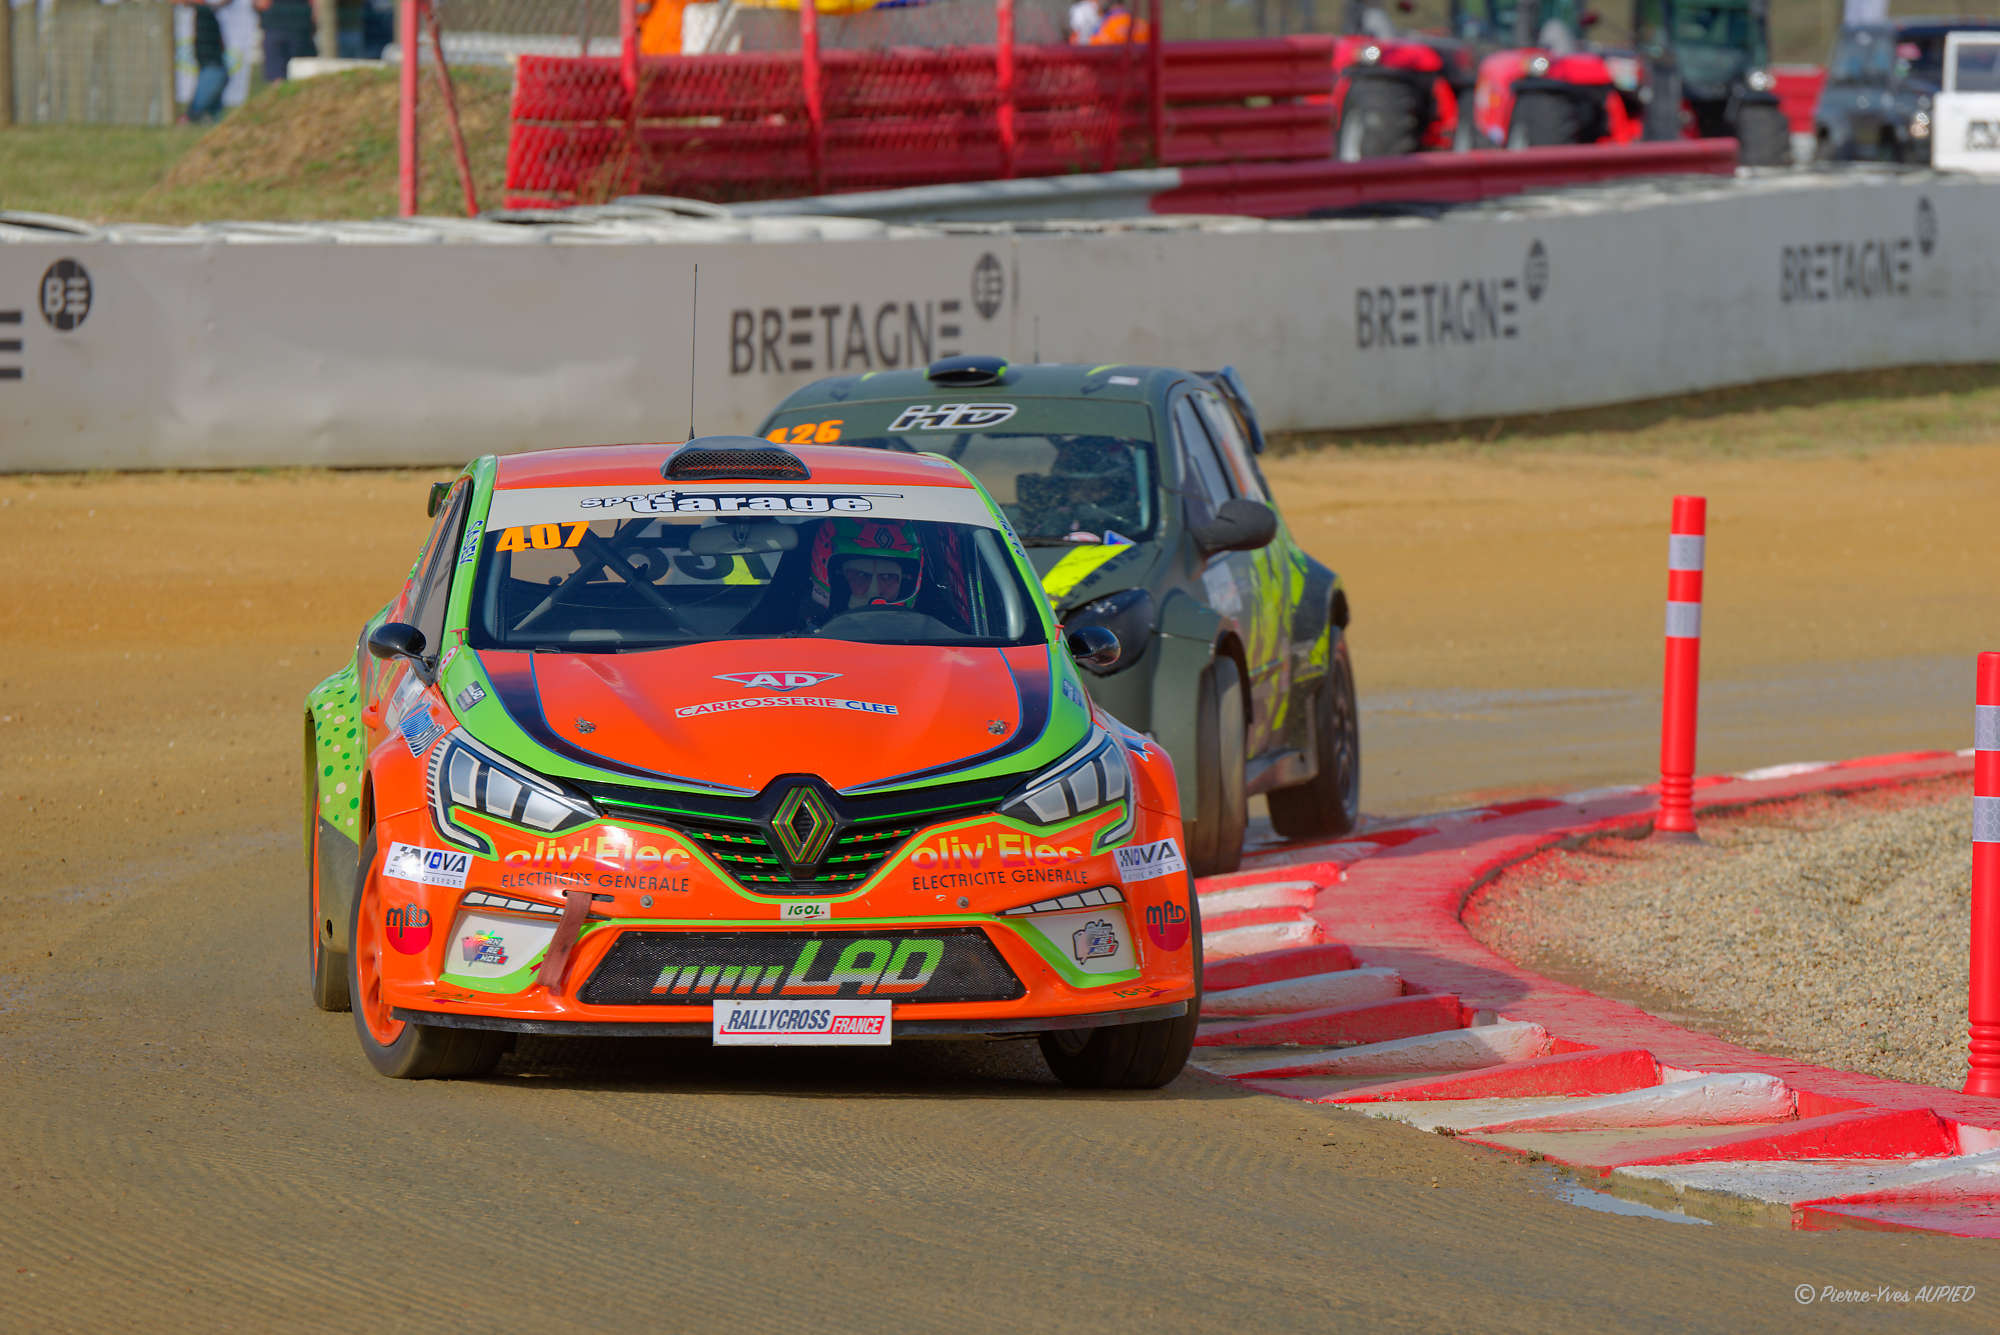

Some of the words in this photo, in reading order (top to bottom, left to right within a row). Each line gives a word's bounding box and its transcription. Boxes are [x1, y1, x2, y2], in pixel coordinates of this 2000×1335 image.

[1779, 238, 1911, 302] BRETAGNE
[1355, 278, 1520, 349] BRETAGNE
[730, 300, 962, 375] BRETAGNE
[765, 420, 844, 444] 426
[581, 490, 677, 508] sport
[631, 494, 873, 513] Garage
[496, 520, 590, 552] 407
[744, 673, 818, 688] AD
[677, 697, 837, 718] CARROSSERIE
[846, 701, 897, 714] CLEE
[502, 871, 592, 888] ELECTRICITE
[598, 874, 689, 892] GENERALE
[913, 871, 1005, 890] ELECTRICITE
[1012, 869, 1088, 885] GENERALE
[780, 939, 944, 995] LAD
[728, 1009, 830, 1030] RALLYCROSS
[832, 1017, 883, 1033] FRANCE
